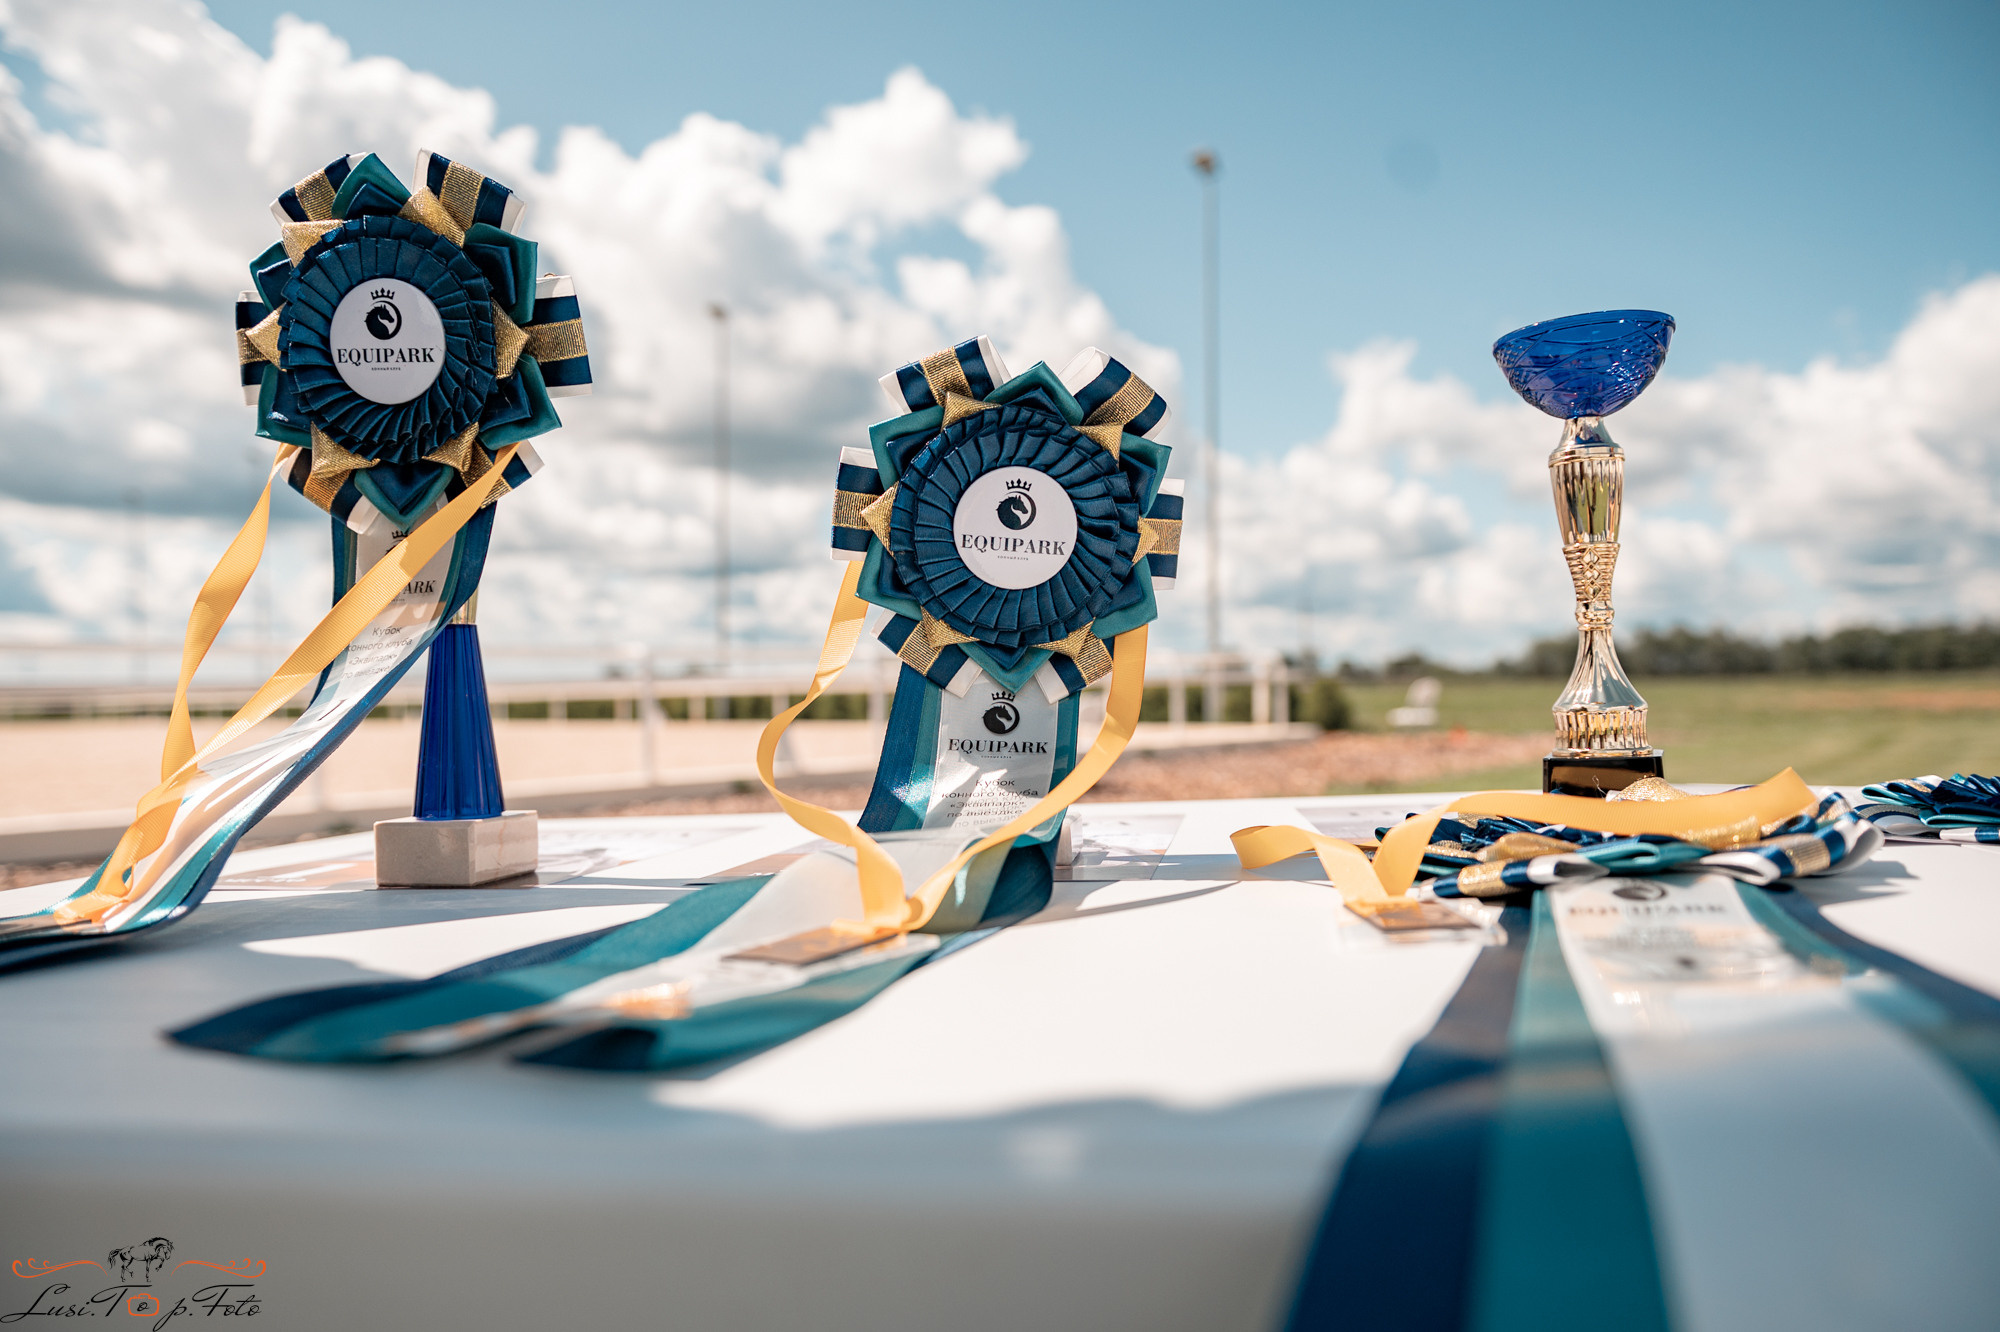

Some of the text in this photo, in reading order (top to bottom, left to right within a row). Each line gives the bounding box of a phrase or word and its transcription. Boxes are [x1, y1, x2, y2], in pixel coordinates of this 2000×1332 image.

[337, 347, 435, 367] EQUIPARK
[961, 533, 1066, 556] EQUIPARK
[372, 626, 401, 637] Кубок
[948, 738, 1048, 755] EQUIPARK
[975, 779, 1015, 787] Кубок
[941, 788, 1039, 799] конного клуба
